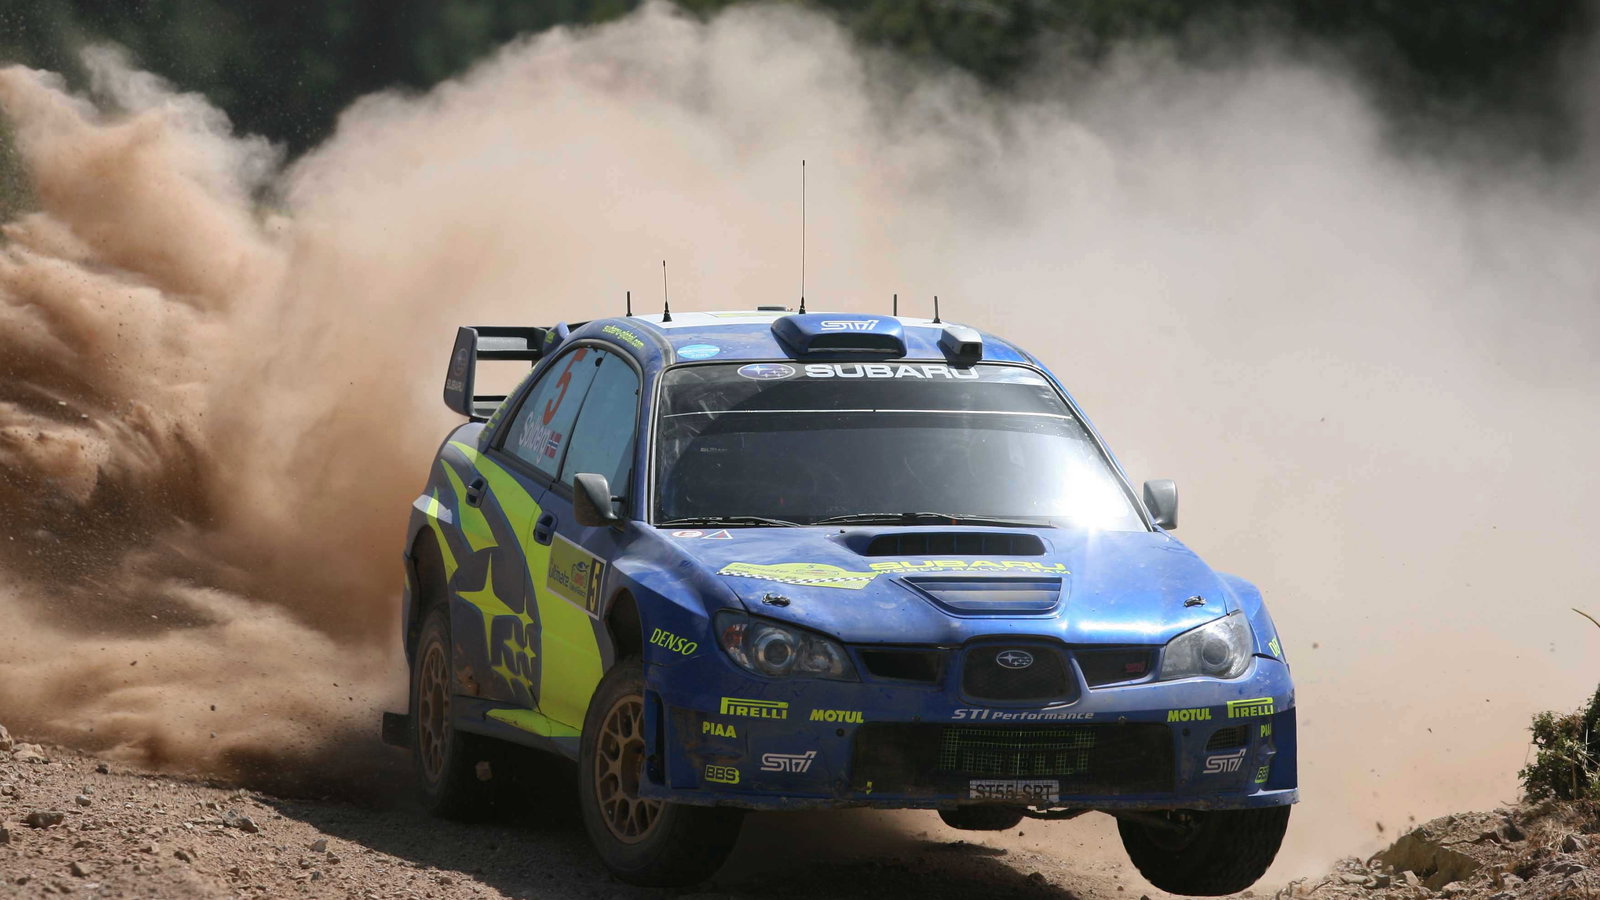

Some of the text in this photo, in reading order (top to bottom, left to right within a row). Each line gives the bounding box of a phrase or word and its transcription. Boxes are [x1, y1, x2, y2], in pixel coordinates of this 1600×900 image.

[805, 364, 979, 379] SUBARU
[543, 347, 588, 425] 5
[869, 560, 1066, 571] SUBARU
[590, 562, 601, 612] 5
[649, 628, 697, 655] DENSO
[720, 697, 788, 719] PIRELLI
[810, 709, 863, 723] MOTUL
[952, 709, 1094, 720] STI Performance
[1167, 708, 1212, 722] MOTUL
[1226, 697, 1274, 718] PIRELLI
[702, 721, 736, 738] PIAA
[705, 765, 739, 784] BBS
[976, 783, 1013, 799] ST55
